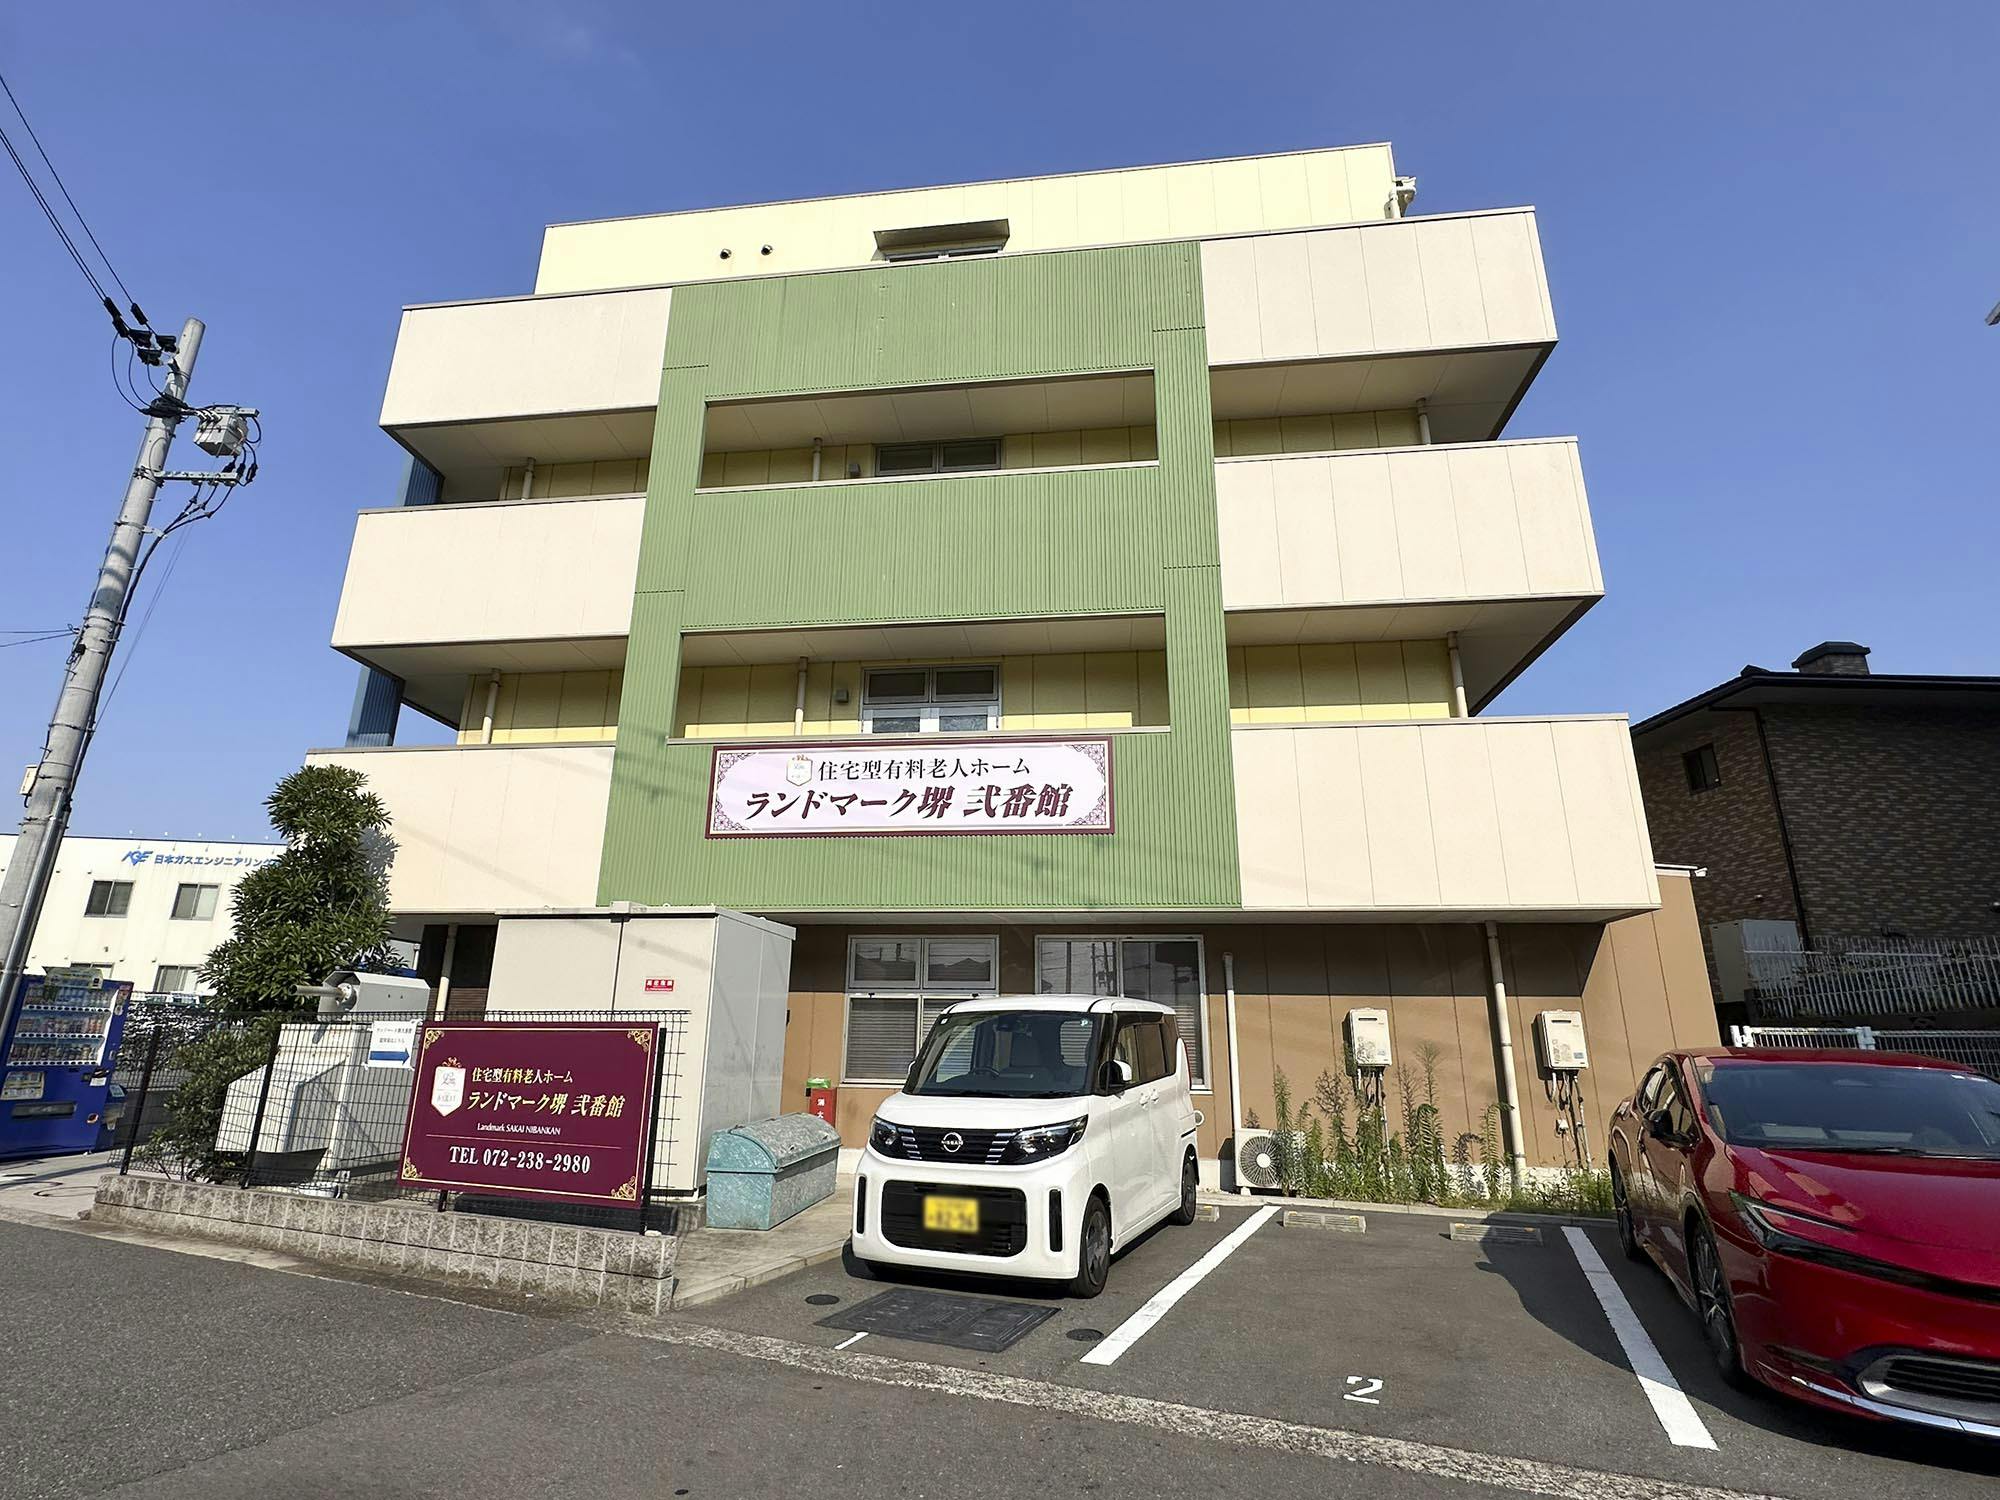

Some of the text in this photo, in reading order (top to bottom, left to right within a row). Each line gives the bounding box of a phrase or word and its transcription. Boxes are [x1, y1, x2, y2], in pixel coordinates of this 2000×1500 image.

[817, 757, 1030, 781] 住宅型有料老人ホーム
[745, 783, 1074, 820] ランドマーク堺 弐番館
[472, 1067, 574, 1084] 住宅型有料老人ホーム
[467, 1091, 626, 1118] ランドマーク堺 弐番館
[477, 1122, 561, 1135] Landmark SAKAI NIBANKAN
[449, 1146, 591, 1174] TEL 072-238-2980
[1343, 1376, 1384, 1405] 2
